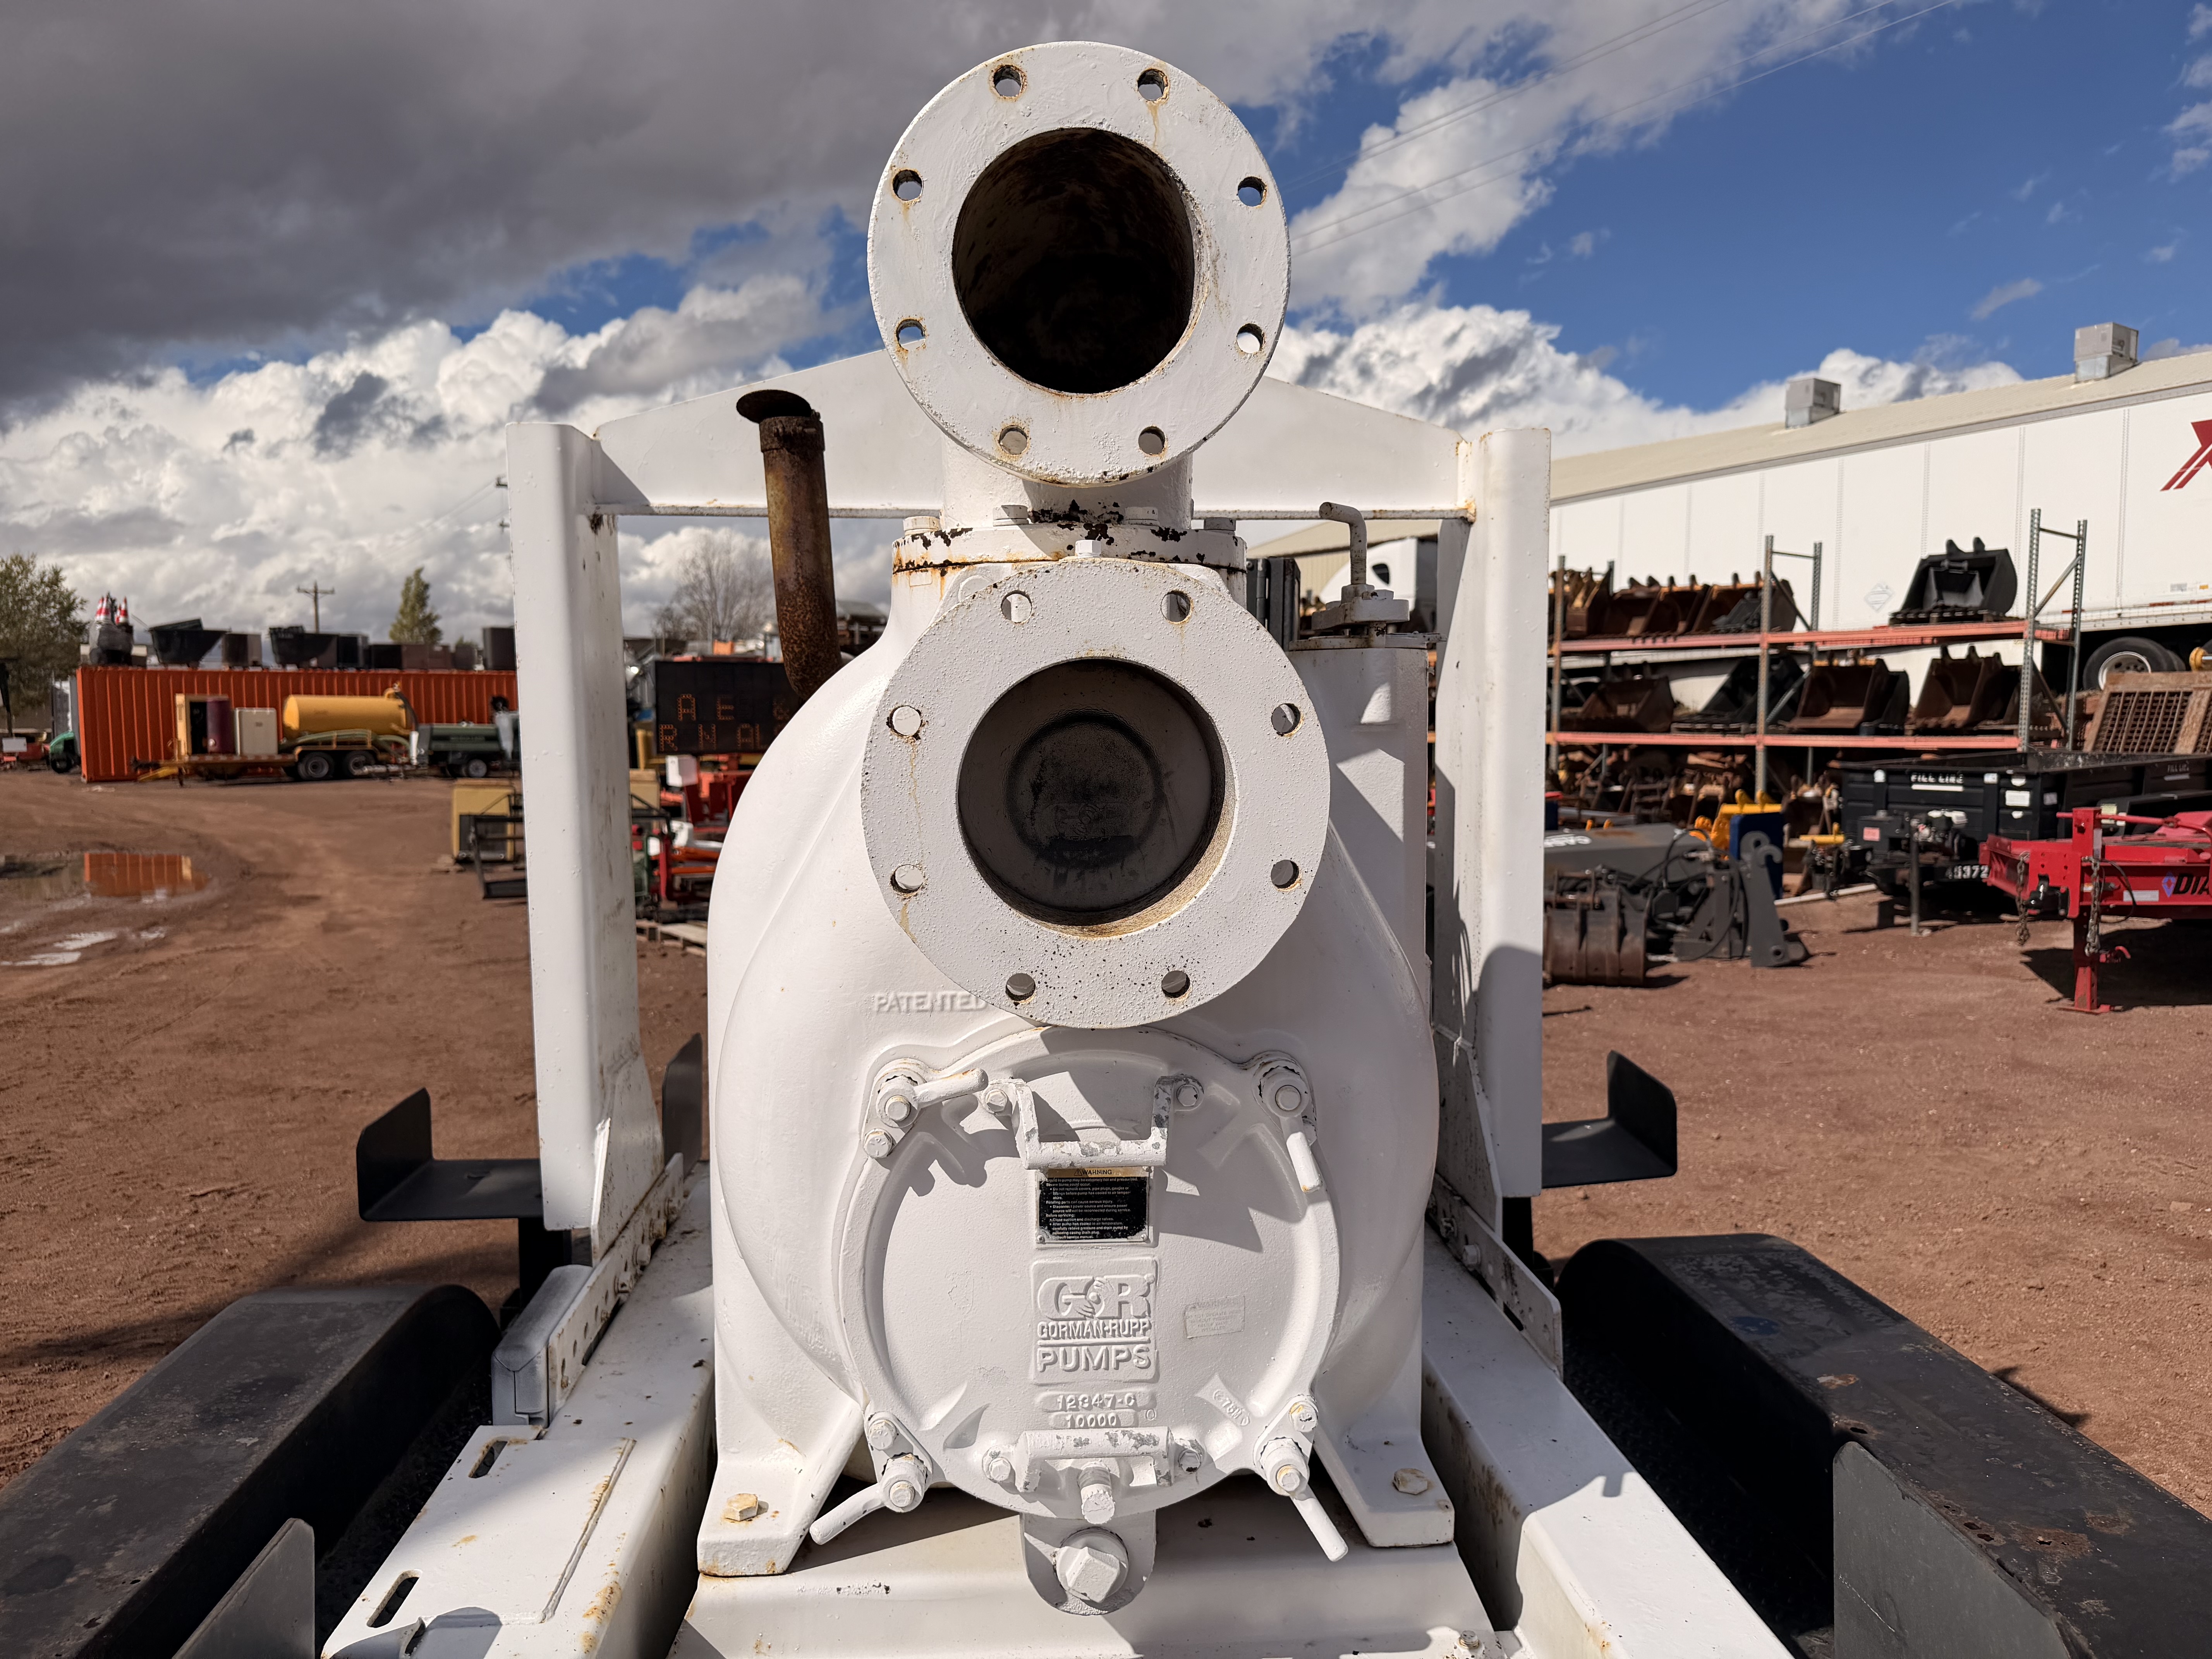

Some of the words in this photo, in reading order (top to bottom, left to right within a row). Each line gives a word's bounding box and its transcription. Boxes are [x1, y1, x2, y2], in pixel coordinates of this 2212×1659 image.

[1910, 773, 1936, 783] FILL
[1938, 773, 1963, 783] LINE
[874, 991, 988, 1013] PATENTED
[1037, 1319, 1152, 1340] GORMAN-RUPP
[1037, 1344, 1152, 1372] PUMPS
